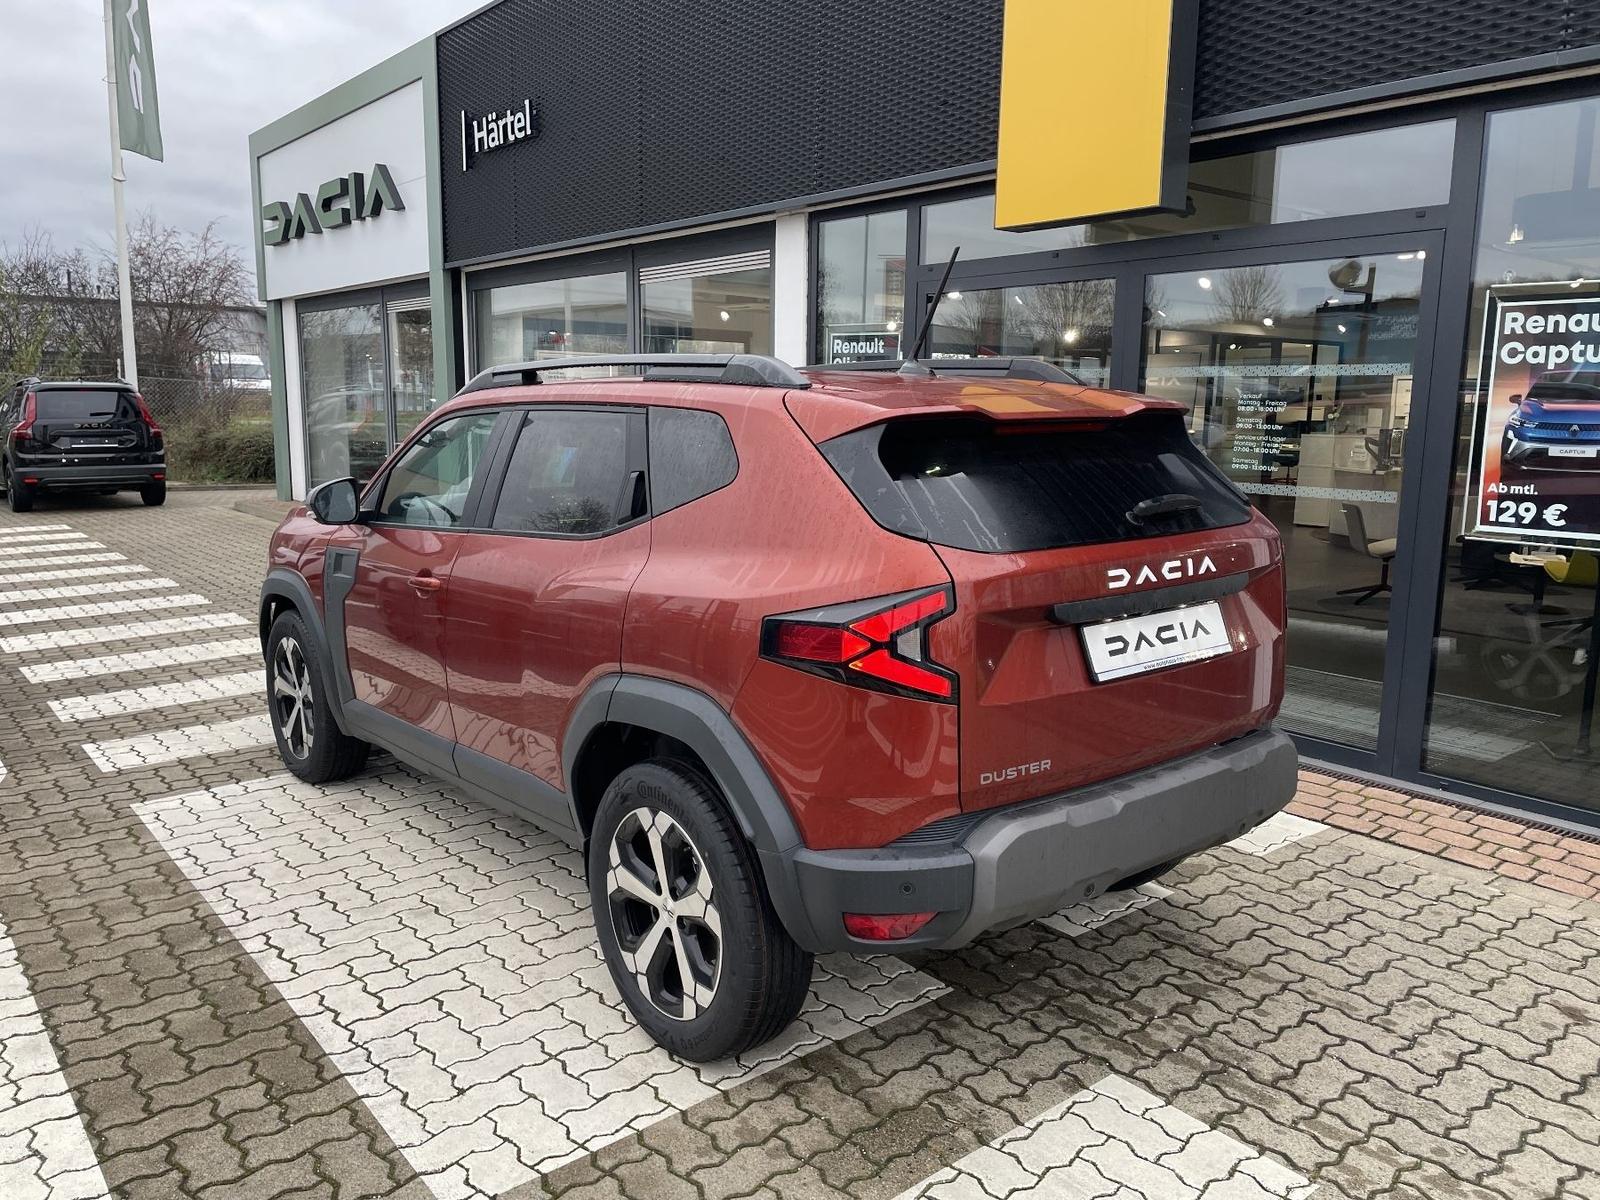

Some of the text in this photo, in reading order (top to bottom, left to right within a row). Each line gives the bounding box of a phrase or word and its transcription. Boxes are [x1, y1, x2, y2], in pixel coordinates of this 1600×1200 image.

[473, 99, 532, 153] Härtel
[262, 163, 406, 246] DACIA
[833, 337, 885, 354] Renault
[1500, 341, 1600, 370] Captu
[1236, 416, 1263, 424] Samstag
[1233, 440, 1257, 448] Montag
[1268, 435, 1287, 443] Lager
[1232, 457, 1259, 465] Samstag
[1487, 483, 1539, 496] Ab mtl.
[1486, 500, 1569, 528] 129 €
[1107, 555, 1217, 589] DACIA
[1105, 619, 1211, 658] DACIA
[980, 759, 1052, 785] DUSTER
